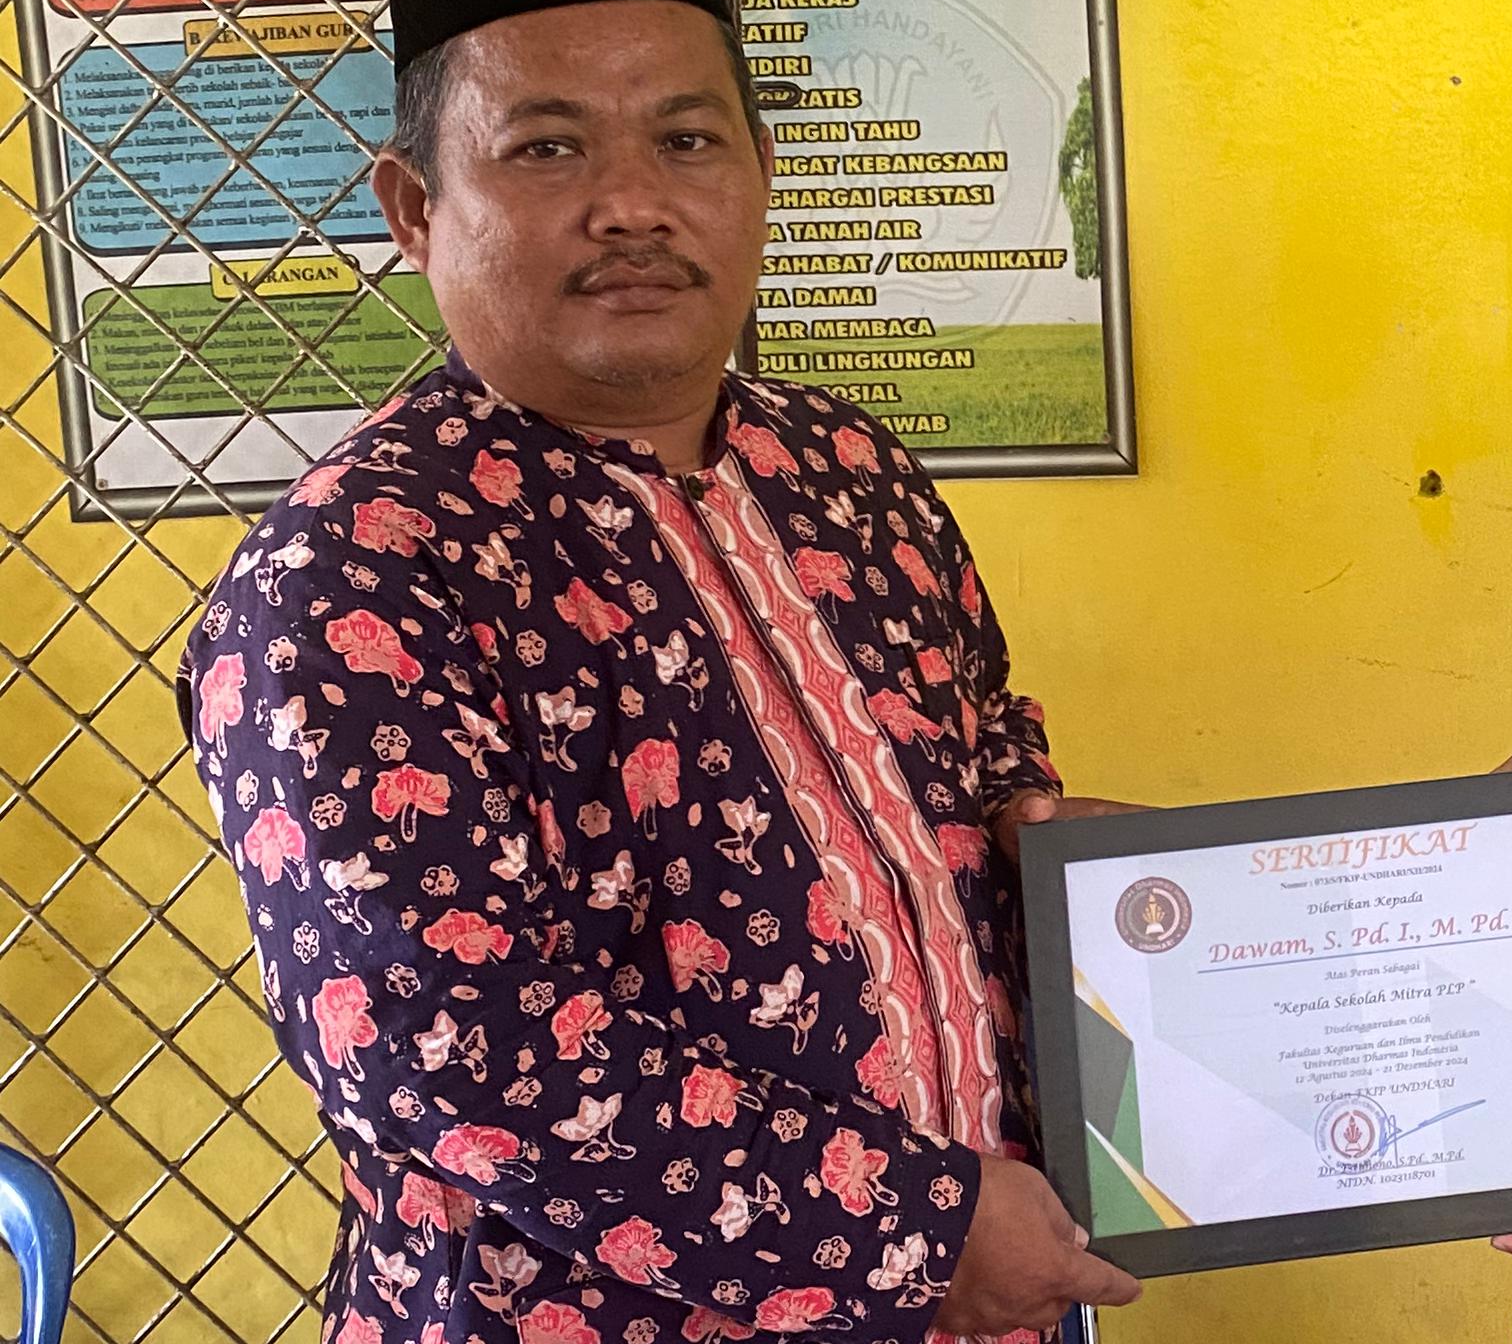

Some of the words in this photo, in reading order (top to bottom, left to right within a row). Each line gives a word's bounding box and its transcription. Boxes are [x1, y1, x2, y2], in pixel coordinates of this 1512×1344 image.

[775, 123, 848, 142] INGIN
[853, 121, 920, 140] TAHU
[844, 152, 1007, 174] KEBANGSAAN
[880, 186, 993, 206] PRESTASI
[788, 222, 871, 241] TANAH
[875, 221, 921, 239] AIR
[876, 253, 893, 275] /
[897, 249, 1067, 271] KOMUNIKATIF
[794, 288, 876, 306] DAMAI
[812, 318, 935, 339] MEMBACA
[814, 350, 974, 371] LINGKUNGAN
[1249, 822, 1478, 875] SERTIFIKAT
[1307, 897, 1370, 916] Diberikan
[1374, 891, 1423, 910] Kepada
[1209, 937, 1314, 963] Dawam,
[1324, 930, 1342, 951] S.
[1352, 922, 1389, 947] Pd.
[1430, 915, 1461, 938] M.
[1472, 909, 1510, 933] Pd.
[1334, 990, 1386, 1009] Sekolah
[1391, 985, 1432, 1002] Mitra
[1437, 982, 1464, 996] PLP
[1390, 1078, 1455, 1094] UNDHARI
